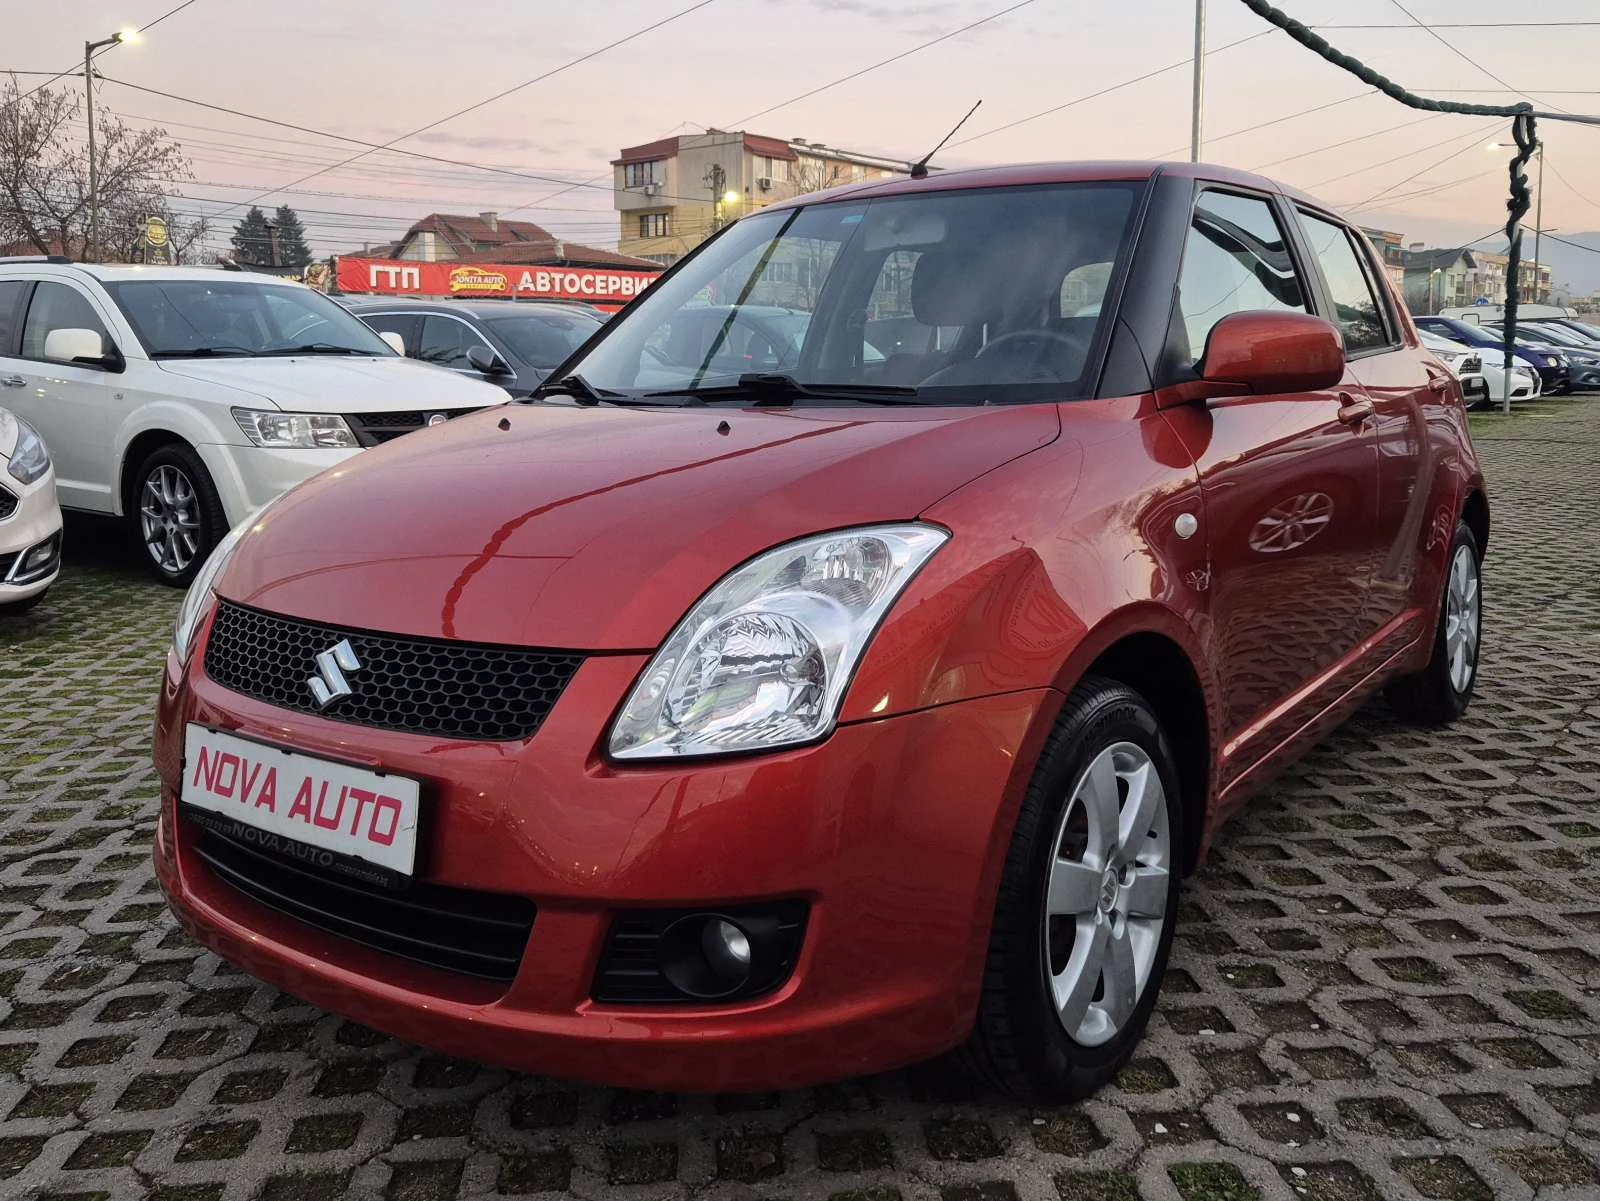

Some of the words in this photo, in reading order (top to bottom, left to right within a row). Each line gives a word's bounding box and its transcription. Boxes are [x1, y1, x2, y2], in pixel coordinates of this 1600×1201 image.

[369, 264, 420, 289] ГТП
[484, 276, 504, 285] AUTO
[518, 271, 656, 296] АВТОСЕРВИ
[192, 745, 277, 814] NOVA
[287, 776, 402, 847] AUTO
[231, 821, 281, 848] NOVA
[284, 840, 334, 867] AUTO
